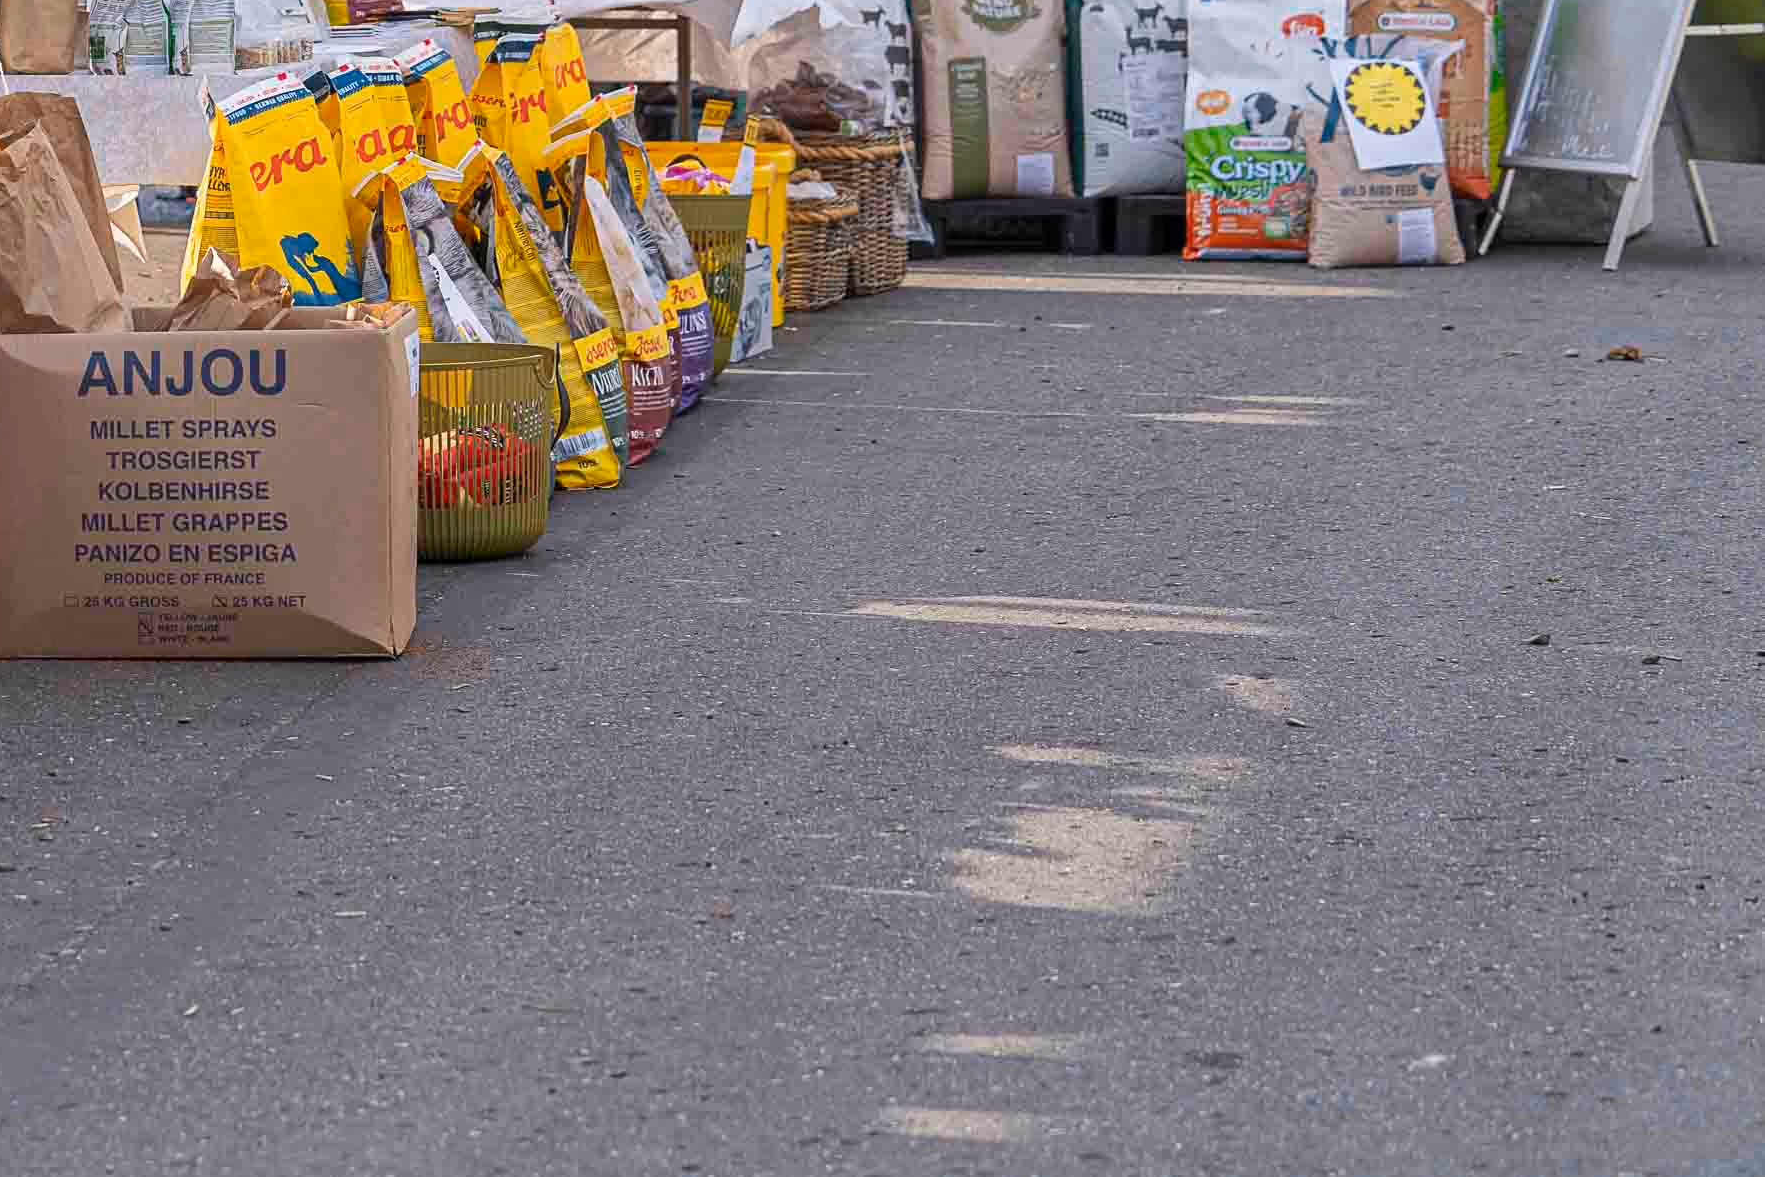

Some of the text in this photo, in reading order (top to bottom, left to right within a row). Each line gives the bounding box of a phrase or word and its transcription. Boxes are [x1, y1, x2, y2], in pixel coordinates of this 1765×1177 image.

[249, 136, 328, 192] era
[1210, 152, 1305, 184] Crispy
[77, 348, 288, 397] ANJOU
[89, 419, 277, 440] MILLET SPRAYS
[105, 450, 262, 470] TROSGIERST
[98, 481, 270, 501] KOLBENHIRSE
[81, 512, 289, 533] MILLET GRAPPES
[74, 543, 297, 564] PANIZO EN ESPIGA
[104, 573, 266, 585] PRODUCE OF FRANCE
[84, 596, 180, 608] 25 KG GROSS
[233, 596, 307, 608] 25 KG NET
